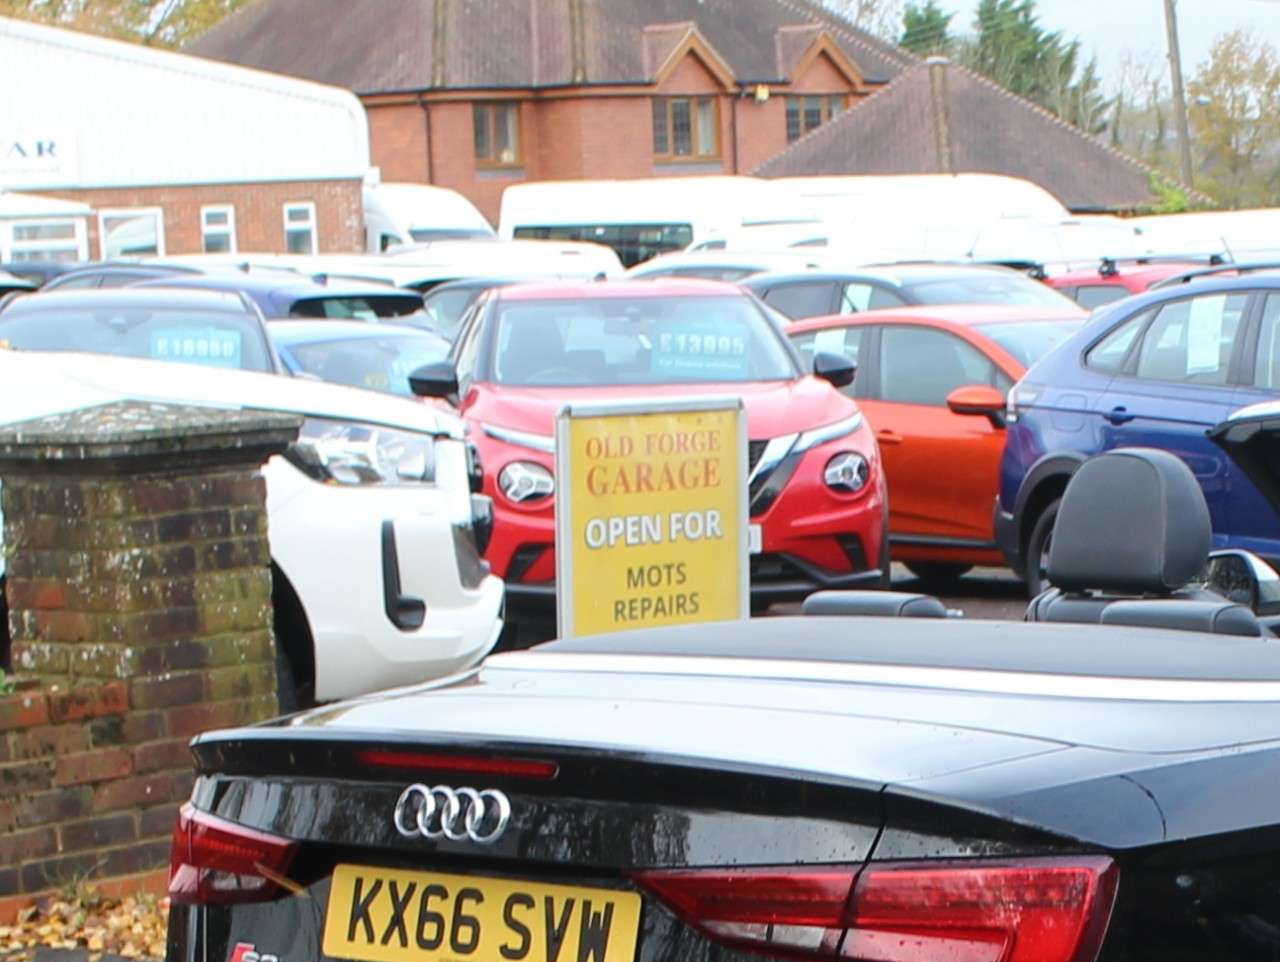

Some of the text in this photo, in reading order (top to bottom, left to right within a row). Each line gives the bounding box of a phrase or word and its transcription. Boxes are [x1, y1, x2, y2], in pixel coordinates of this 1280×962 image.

[586, 430, 721, 460] OLD FORGE
[586, 458, 721, 497] GARAGE
[585, 509, 722, 549] OPEN FOR
[626, 562, 687, 590] MOTS
[614, 592, 700, 623] REPAIRS
[346, 876, 486, 955] KX66
